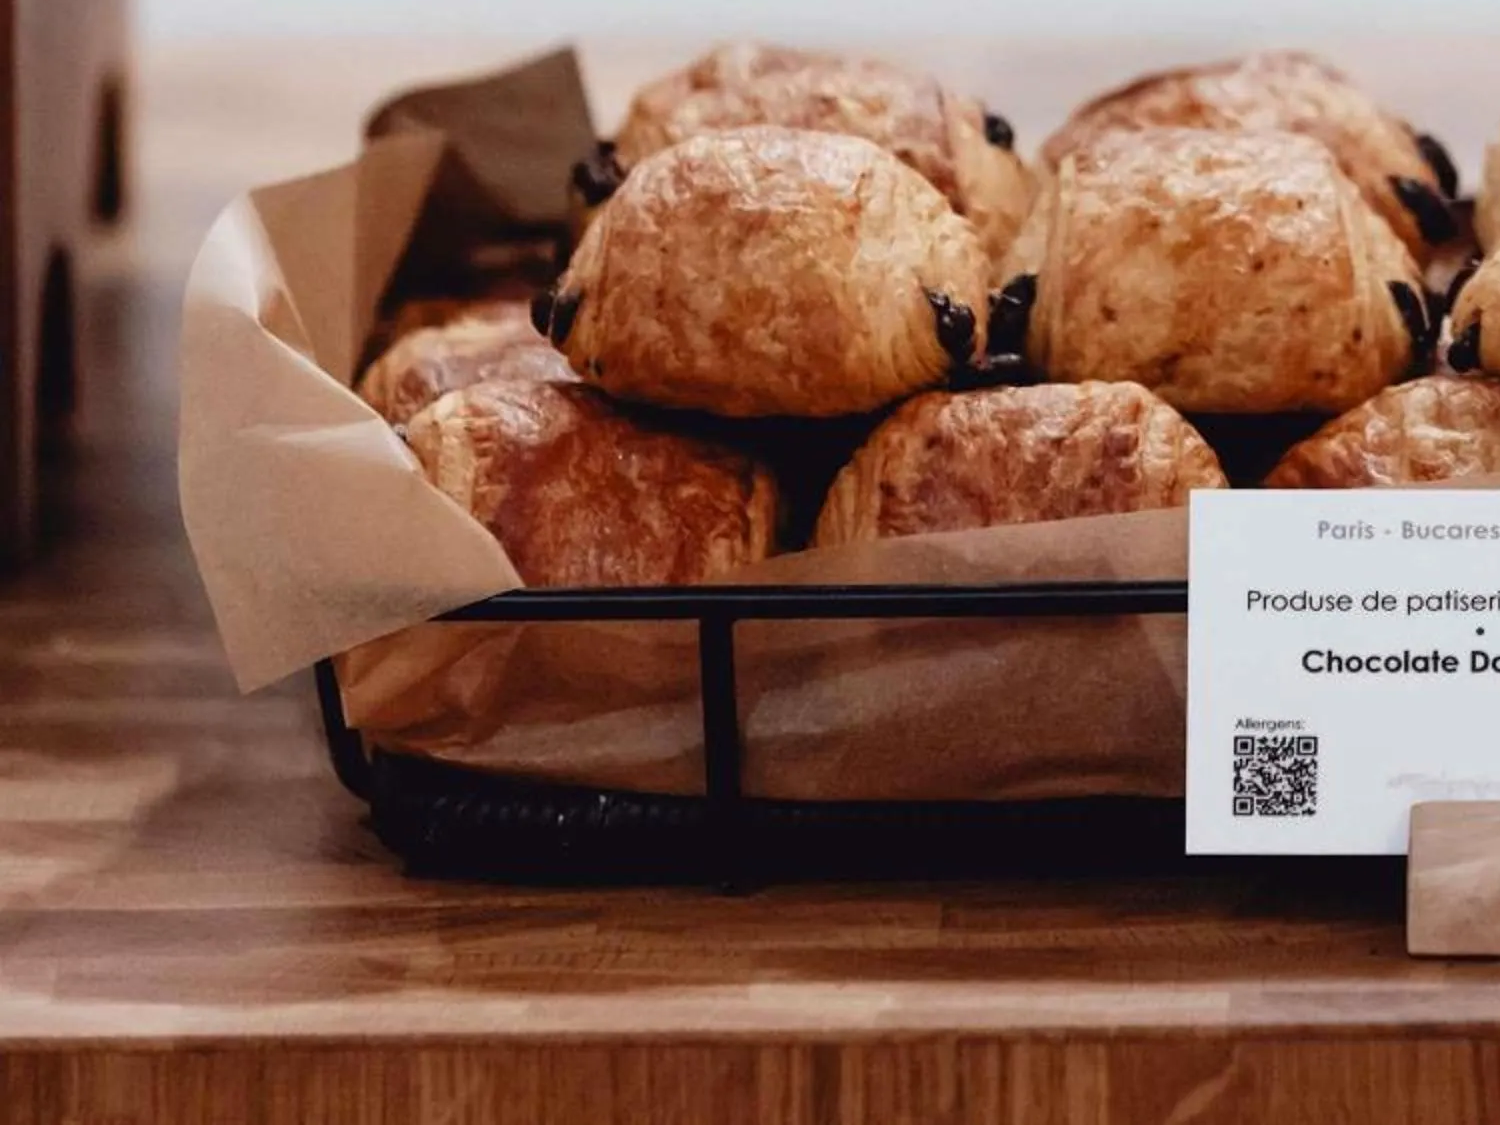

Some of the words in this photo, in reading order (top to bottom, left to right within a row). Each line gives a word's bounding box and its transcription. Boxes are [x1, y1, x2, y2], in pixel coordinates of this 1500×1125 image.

[1317, 520, 1375, 540] Paris
[1246, 589, 1354, 613] Produse
[1361, 589, 1398, 613] de
[1301, 649, 1460, 674] Chocolate
[1234, 716, 1306, 733] Allergens:
